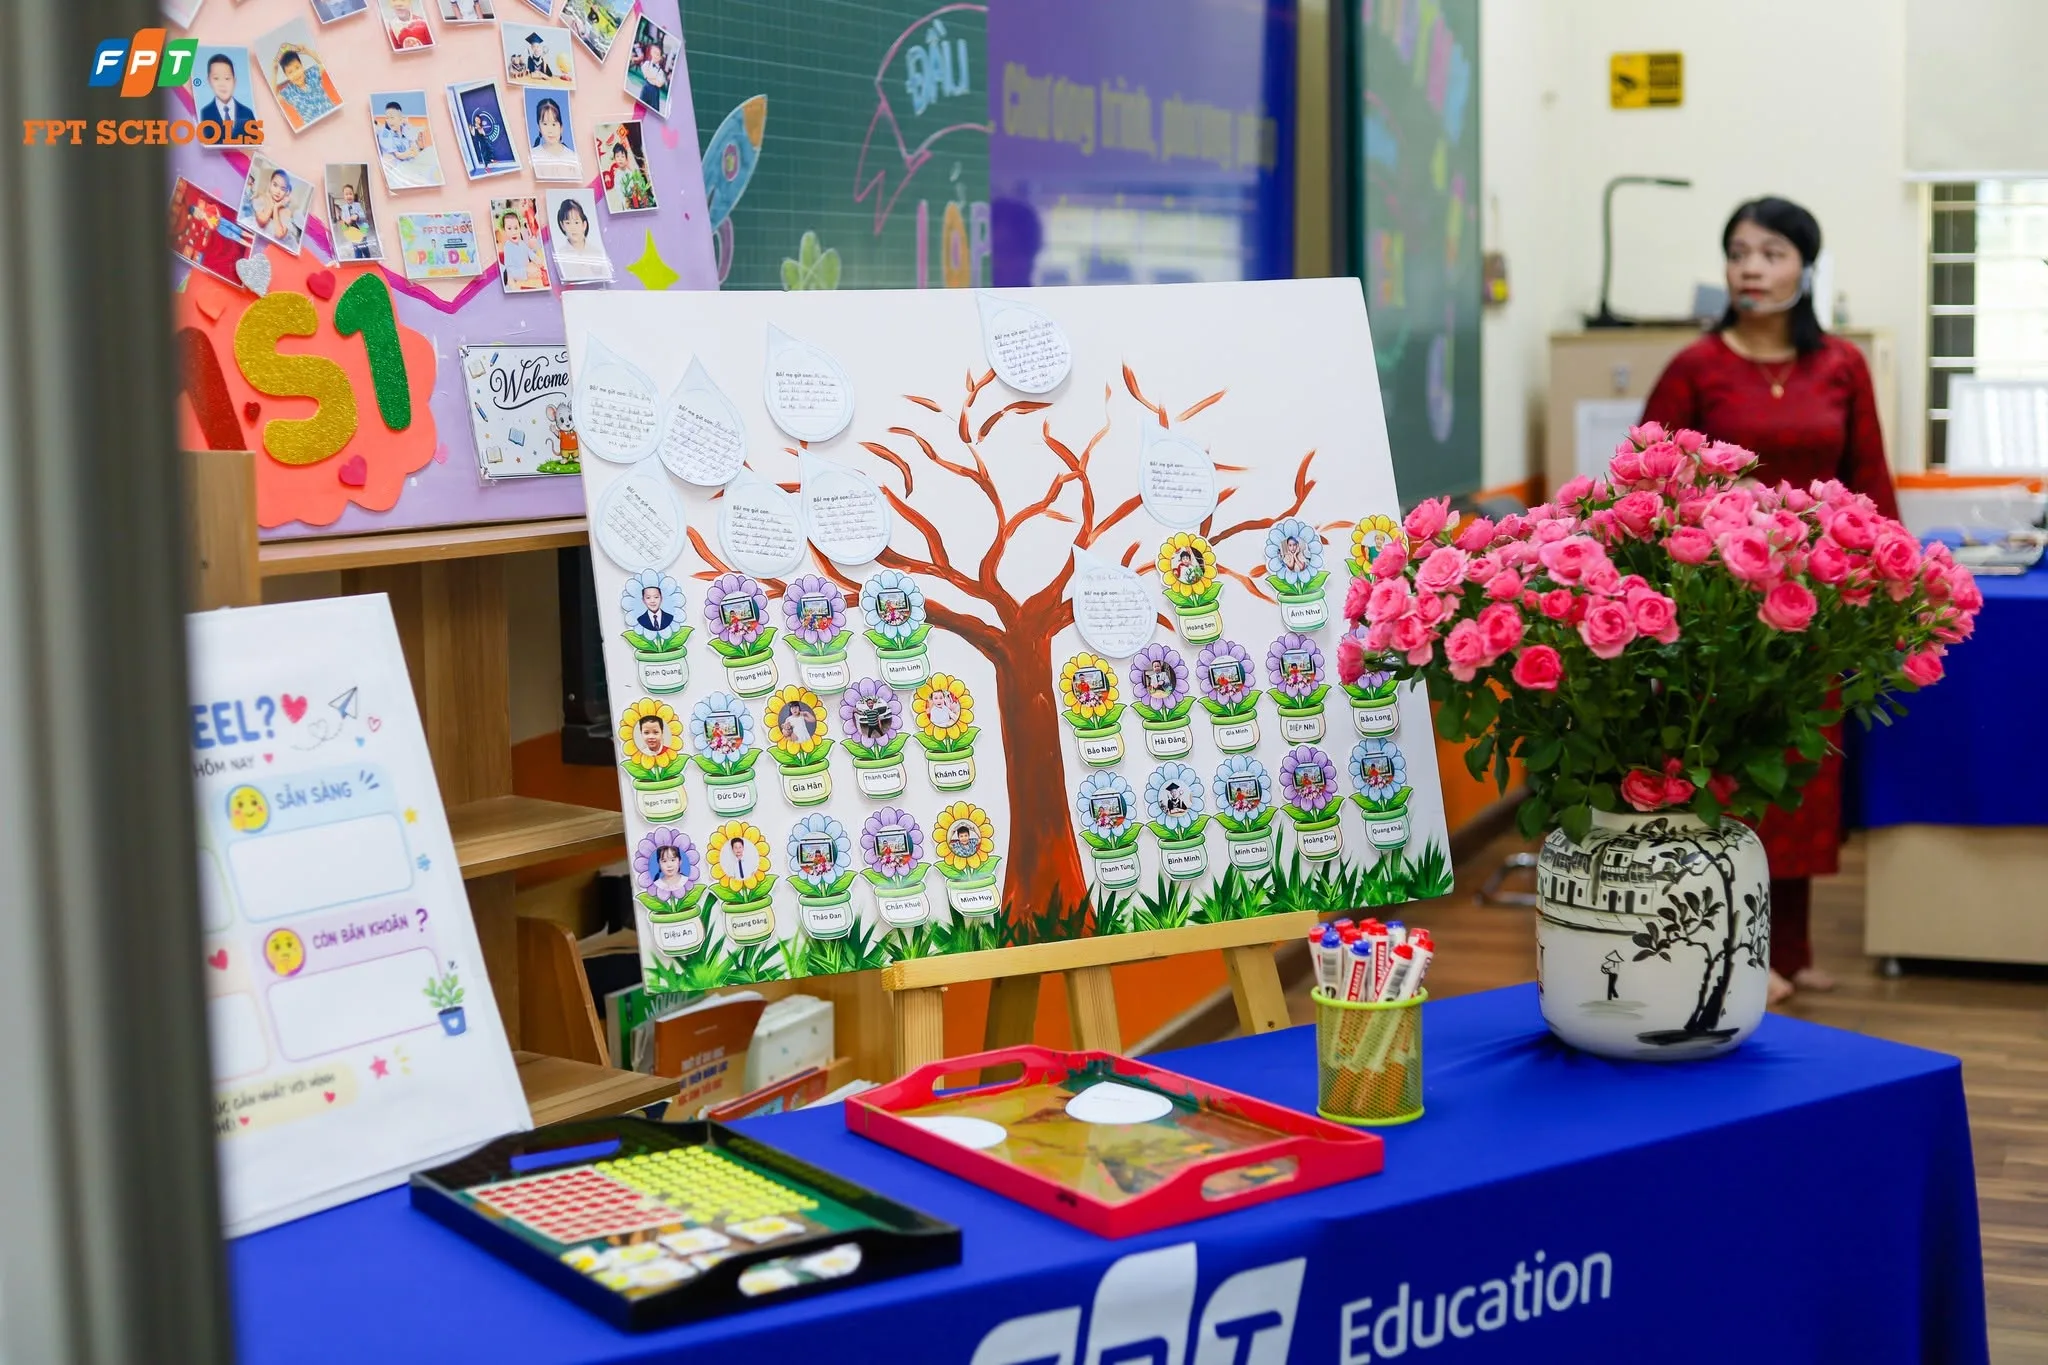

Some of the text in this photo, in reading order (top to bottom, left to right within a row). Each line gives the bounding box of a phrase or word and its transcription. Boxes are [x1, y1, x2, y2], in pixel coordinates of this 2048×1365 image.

[489, 355, 570, 403] Welcome
[1305, 608, 1321, 616] Như
[907, 663, 921, 671] Linh
[661, 669, 682, 677] Quang
[190, 695, 276, 750] EEL?
[1360, 714, 1391, 723] Bảo Long
[1303, 723, 1316, 731] Nhi
[1154, 736, 1167, 745] Hải
[1086, 747, 1101, 755] Bảo
[934, 769, 957, 779] Khánh
[792, 784, 806, 792] Gia
[717, 791, 746, 800] Đức Duy
[1372, 827, 1390, 835] Quang
[960, 895, 978, 903] Minh
[732, 921, 751, 929] Quang
[1339, 1249, 1613, 1365] Education
